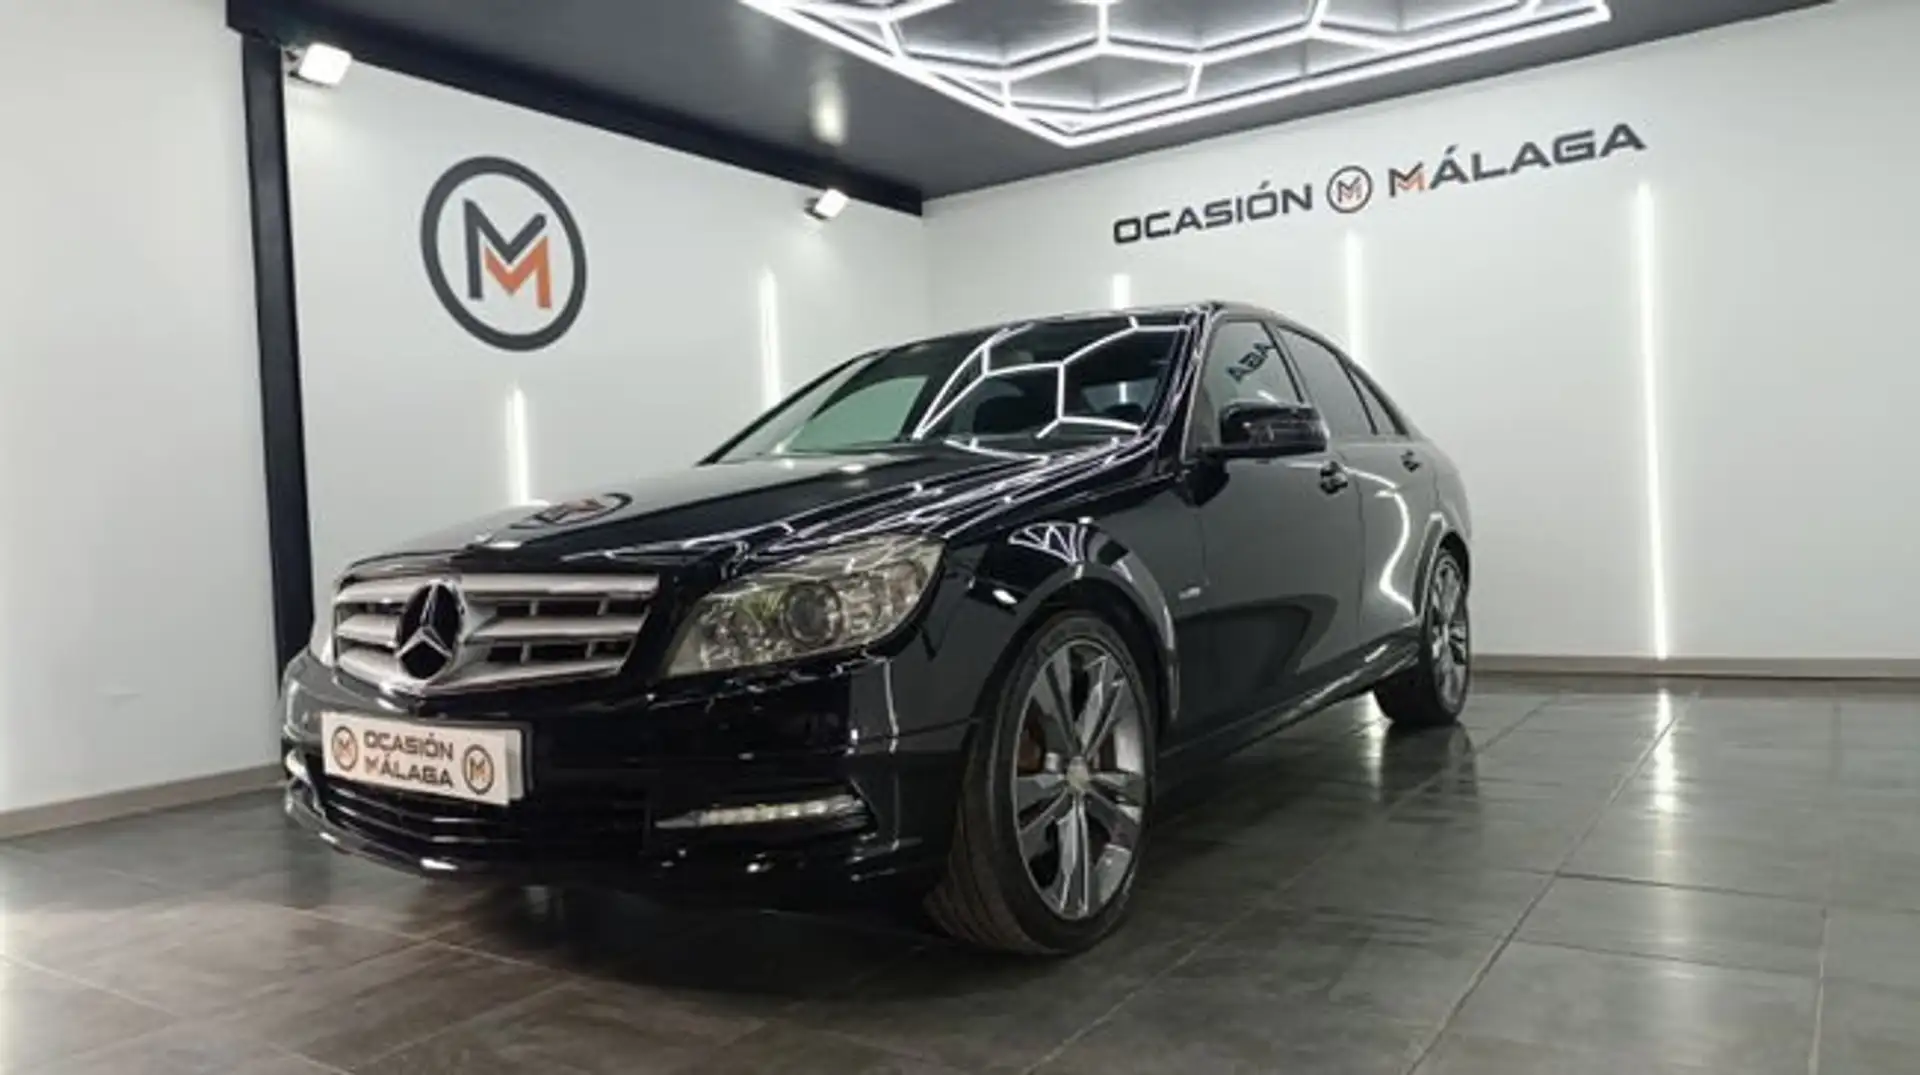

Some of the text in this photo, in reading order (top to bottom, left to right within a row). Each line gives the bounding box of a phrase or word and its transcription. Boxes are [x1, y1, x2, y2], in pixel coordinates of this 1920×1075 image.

[1113, 181, 1313, 244] OCASIÓN
[1388, 123, 1647, 198] MÁLAGA
[363, 730, 454, 761] OCASIÓN
[364, 752, 454, 788] MÁLAGA
